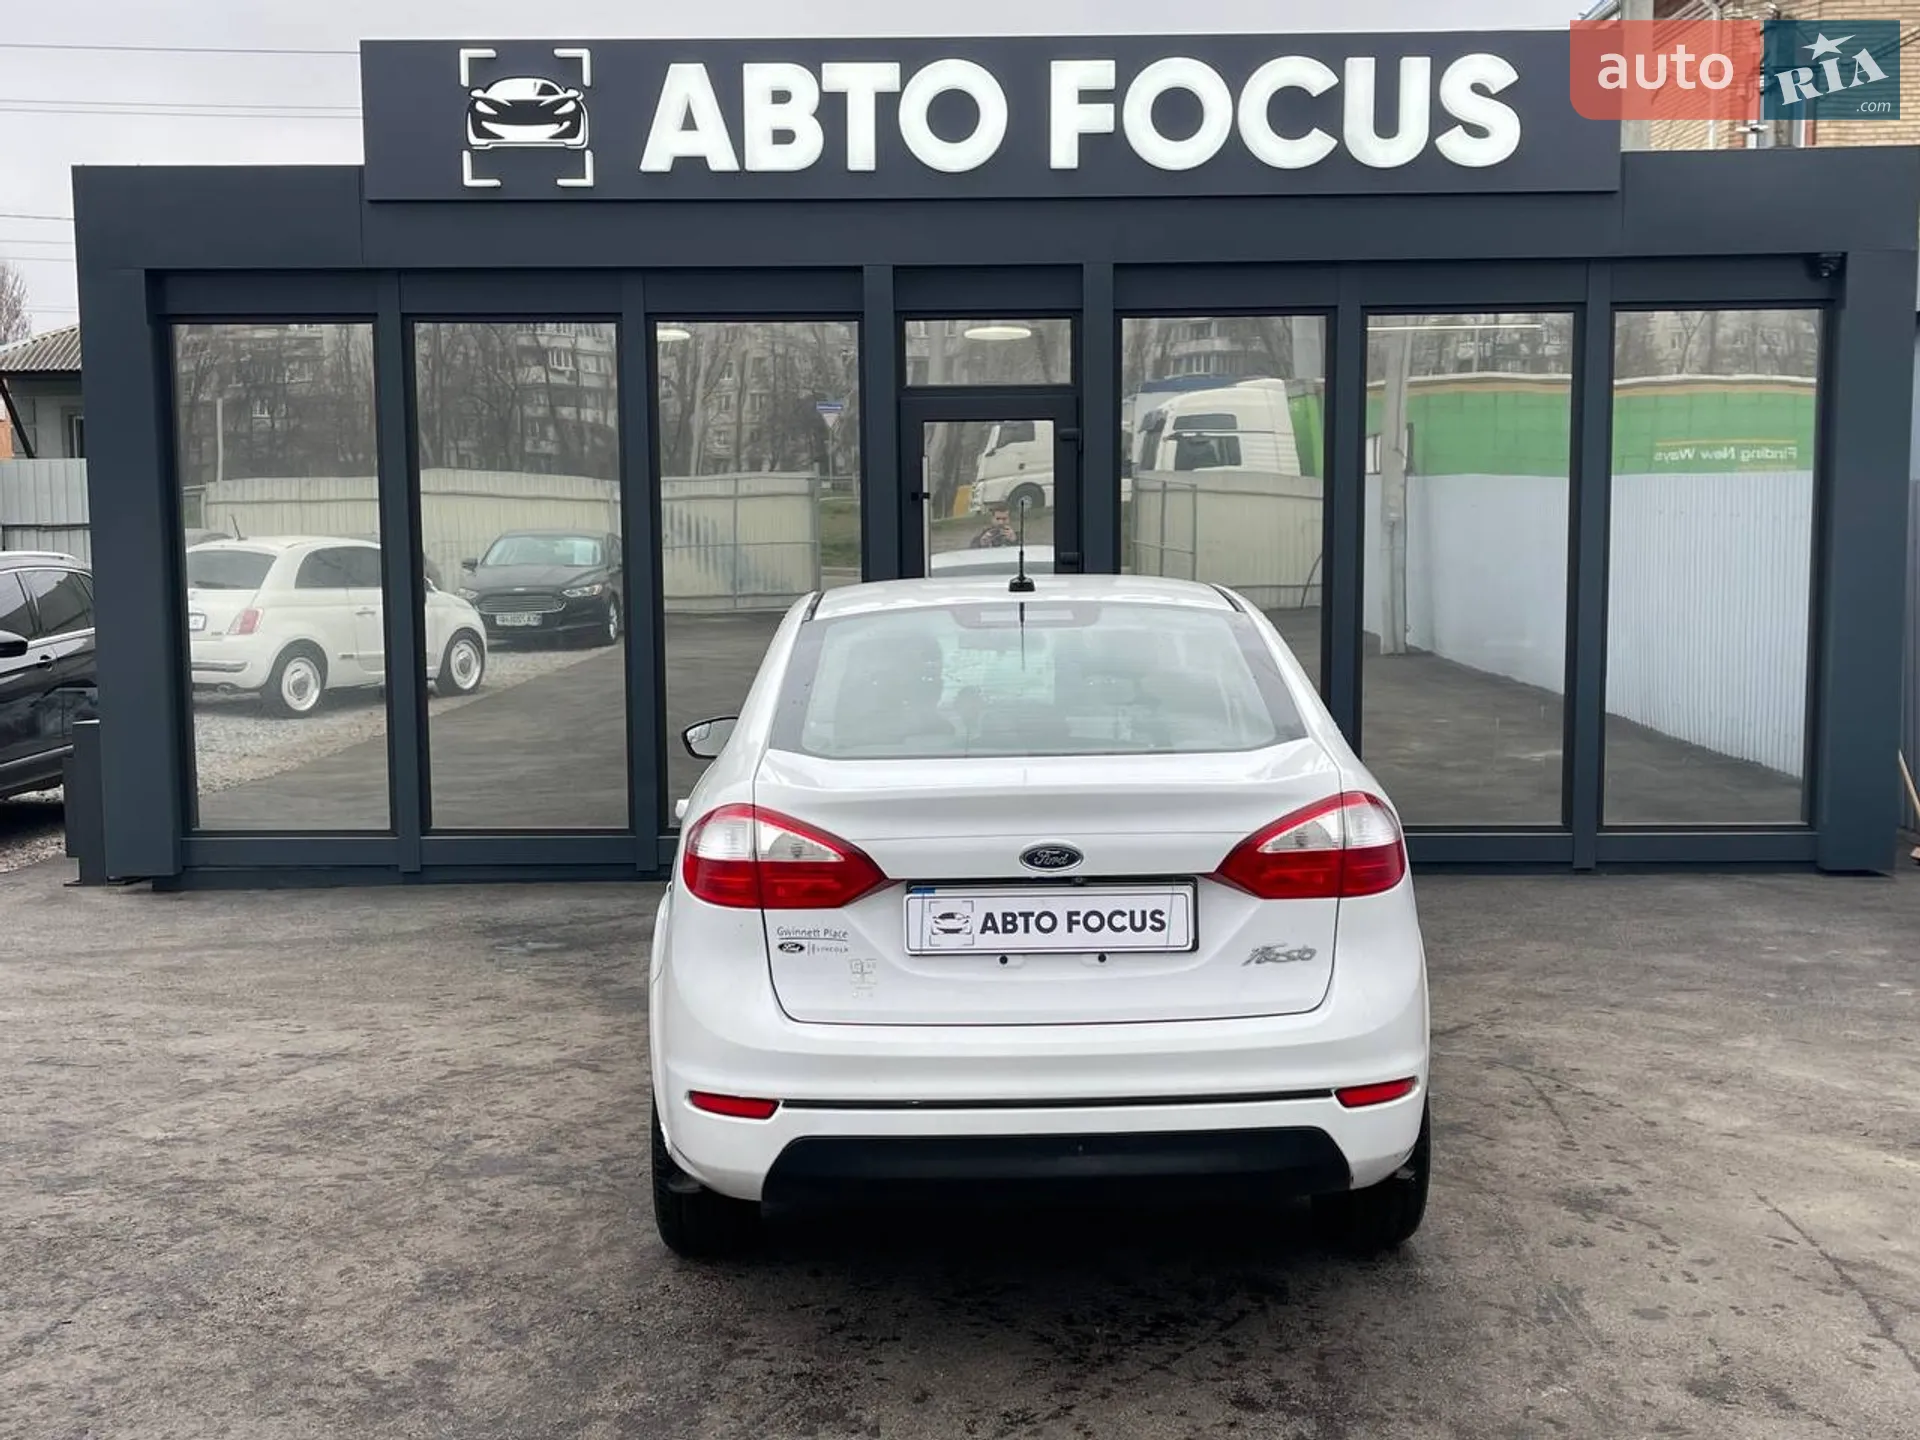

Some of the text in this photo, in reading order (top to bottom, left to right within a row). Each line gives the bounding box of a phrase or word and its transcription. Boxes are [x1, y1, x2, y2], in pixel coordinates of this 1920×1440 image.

[640, 53, 1521, 173] АВТО FOCUS
[979, 909, 1167, 935] АВТО FOCUS
